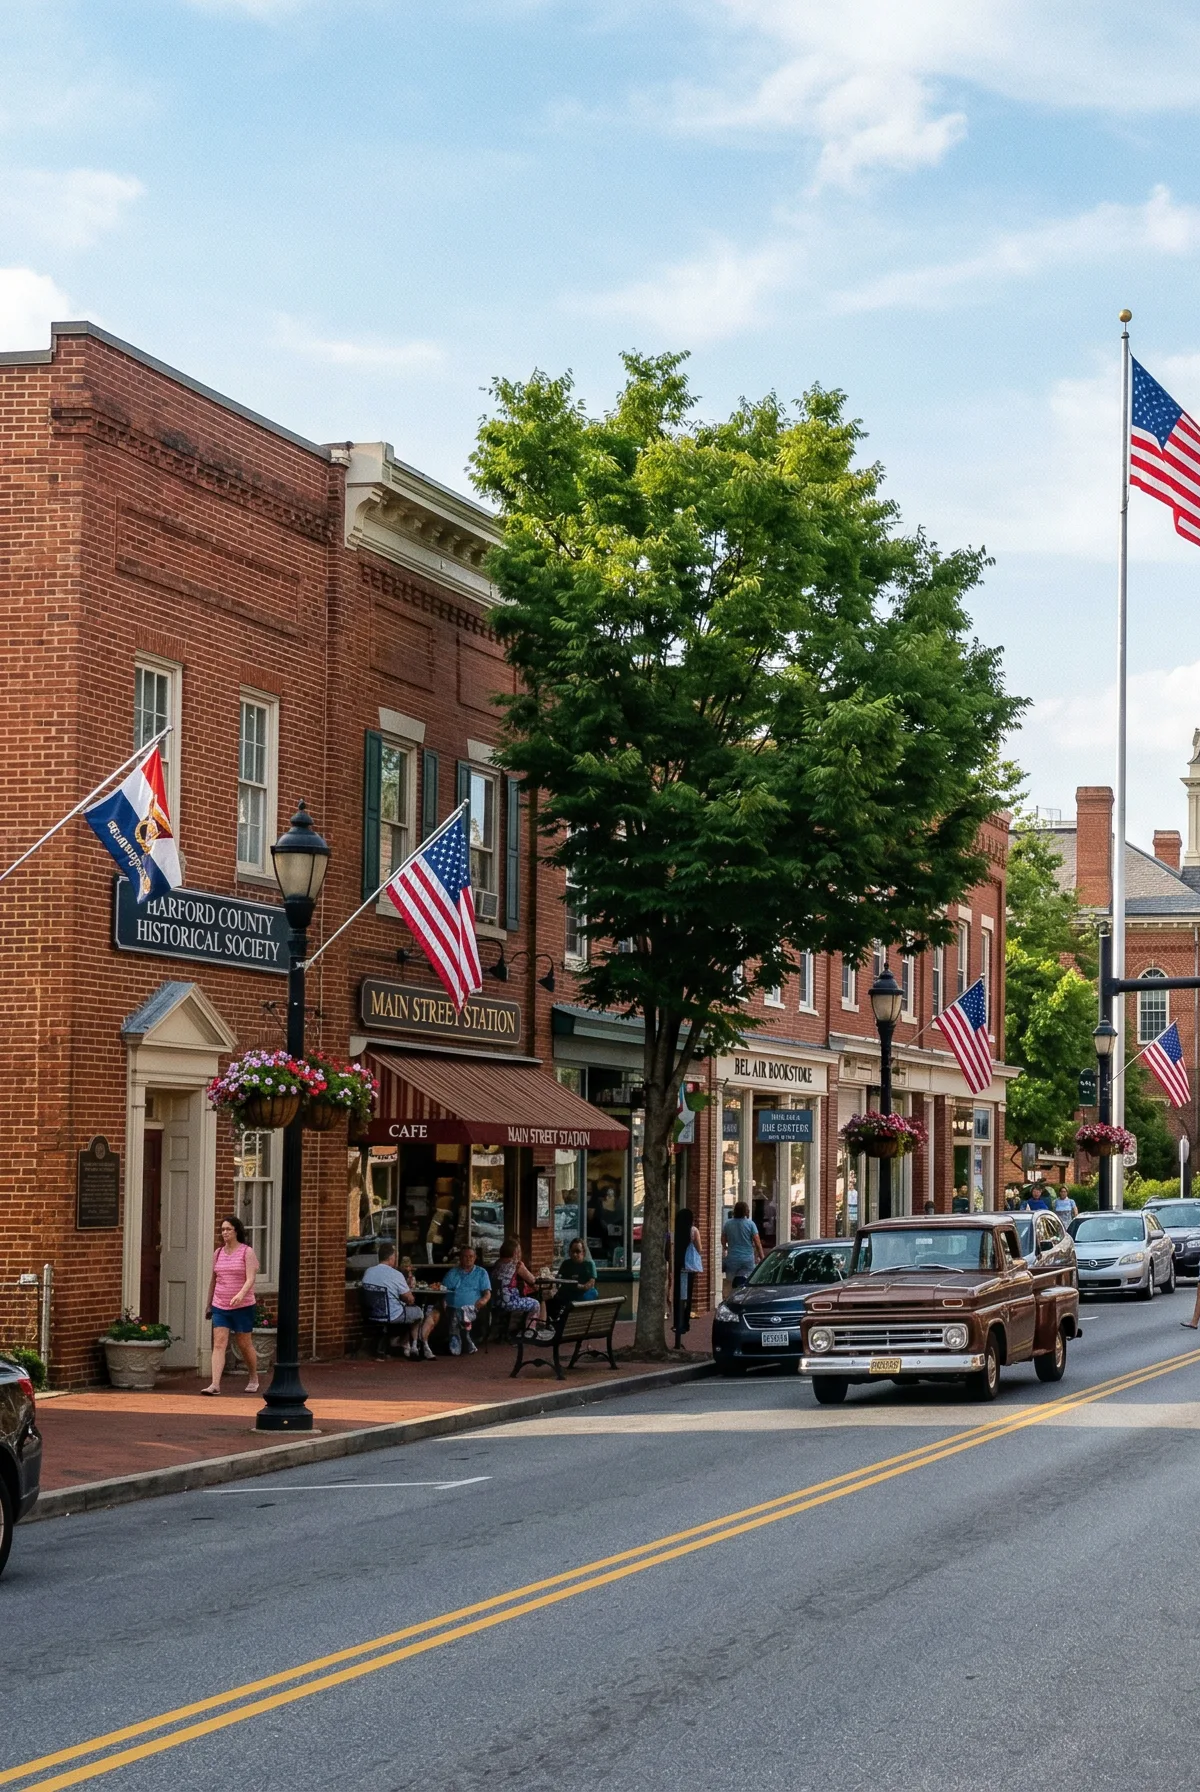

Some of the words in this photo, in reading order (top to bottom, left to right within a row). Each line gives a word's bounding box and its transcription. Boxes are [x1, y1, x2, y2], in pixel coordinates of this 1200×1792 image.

[147, 896, 215, 925] HARFORD
[218, 907, 274, 936] COUNTY
[136, 919, 222, 952] HISTORICAL
[225, 934, 280, 961] SOCIETY
[371, 991, 410, 1020] MAIN
[463, 1004, 516, 1034] STATION
[734, 1057, 751, 1077] BEL
[751, 1060, 767, 1079] AIR
[389, 1125, 428, 1138] CAFE
[530, 1128, 559, 1144] STREET
